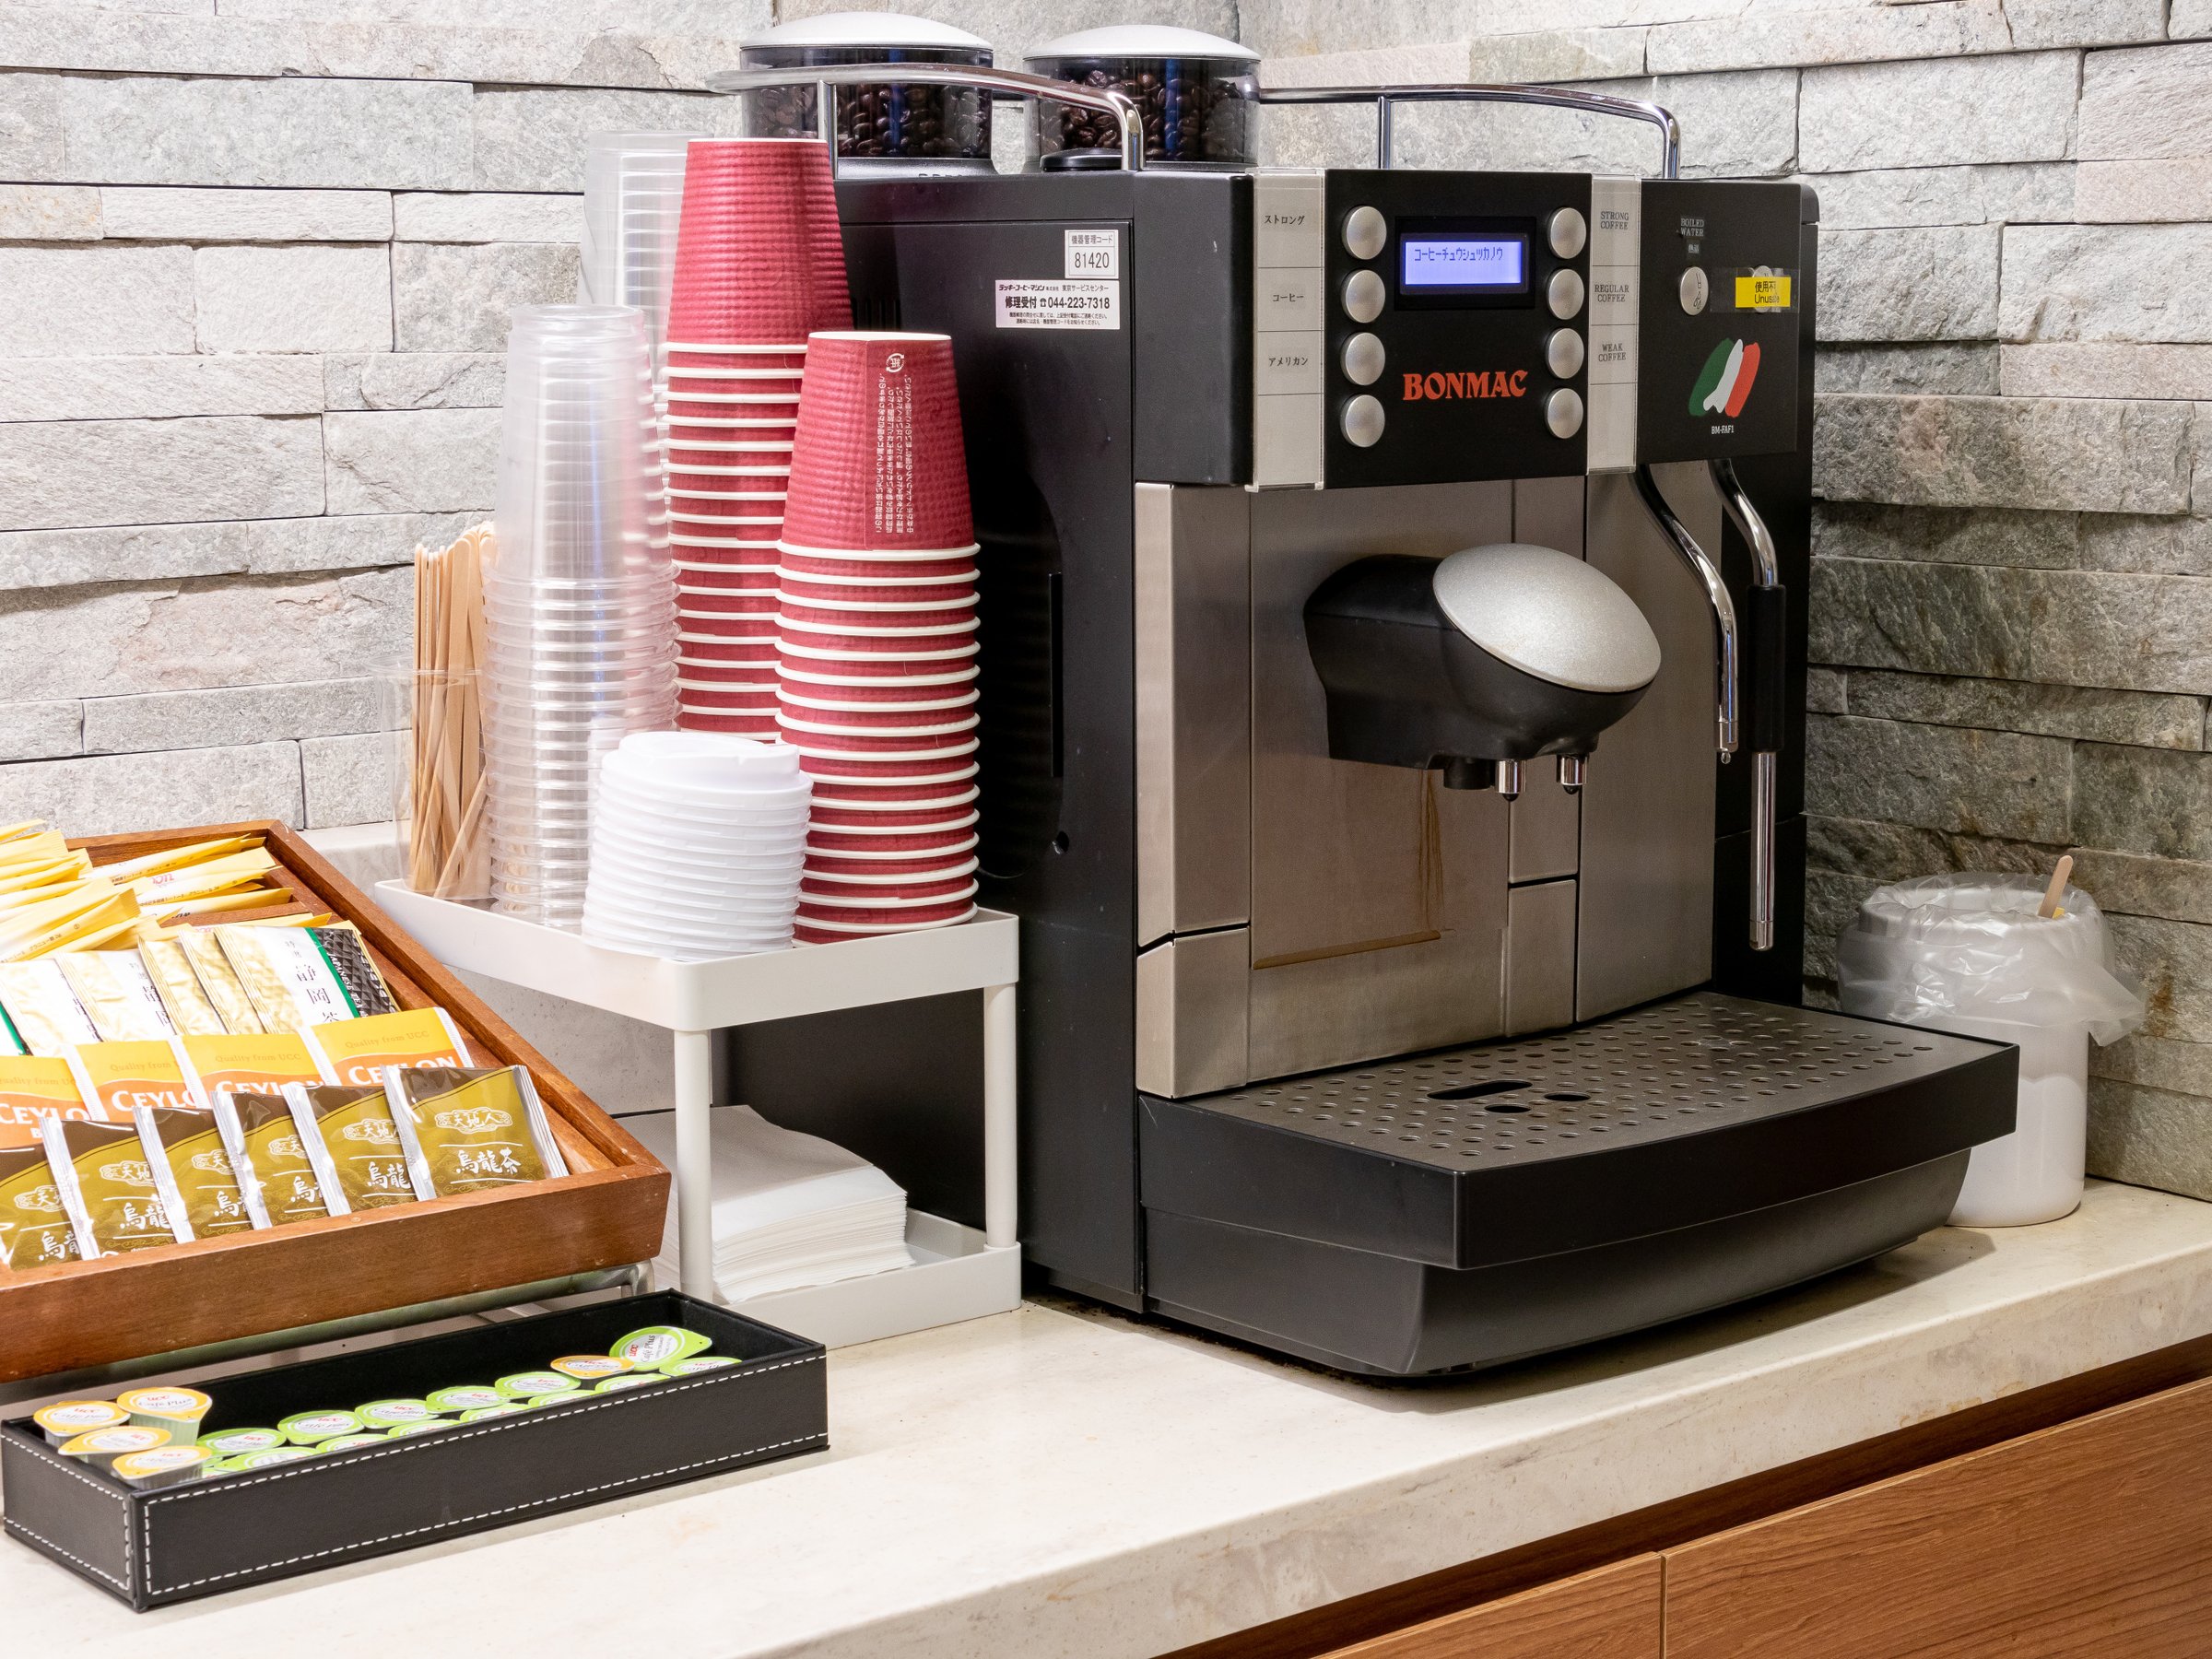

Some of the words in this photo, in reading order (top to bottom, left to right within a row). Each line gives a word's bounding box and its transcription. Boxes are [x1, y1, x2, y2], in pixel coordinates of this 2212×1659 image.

[1264, 214, 1305, 225] ストロング
[1600, 210, 1630, 221] STRONG
[1600, 220, 1629, 230] COFFEE
[1680, 218, 1704, 228] BOILED
[1680, 227, 1704, 237] WATER
[1074, 252, 1110, 269] 81420
[1594, 284, 1630, 294] REGULAR
[1272, 292, 1305, 302] コーヒー
[1597, 293, 1626, 303] COFFEE
[1006, 296, 1037, 310] 修理受付
[1048, 297, 1111, 310] 044-223-7318
[1601, 343, 1623, 353] WEAK
[1268, 357, 1309, 367] アメリカン
[1598, 351, 1627, 362] COFFEE
[1403, 370, 1529, 401] BONMAC
[327, 952, 354, 991] JAPANESE
[345, 1038, 380, 1049] Quality
[382, 1035, 406, 1044] from
[407, 1030, 429, 1040] UCC
[0, 1077, 31, 1087] uality
[453, 1112, 504, 1128] 天地人
[455, 1147, 522, 1175] 烏龍茶
[367, 1160, 411, 1189] 烏龍
[119, 1202, 172, 1230] 烏龍
